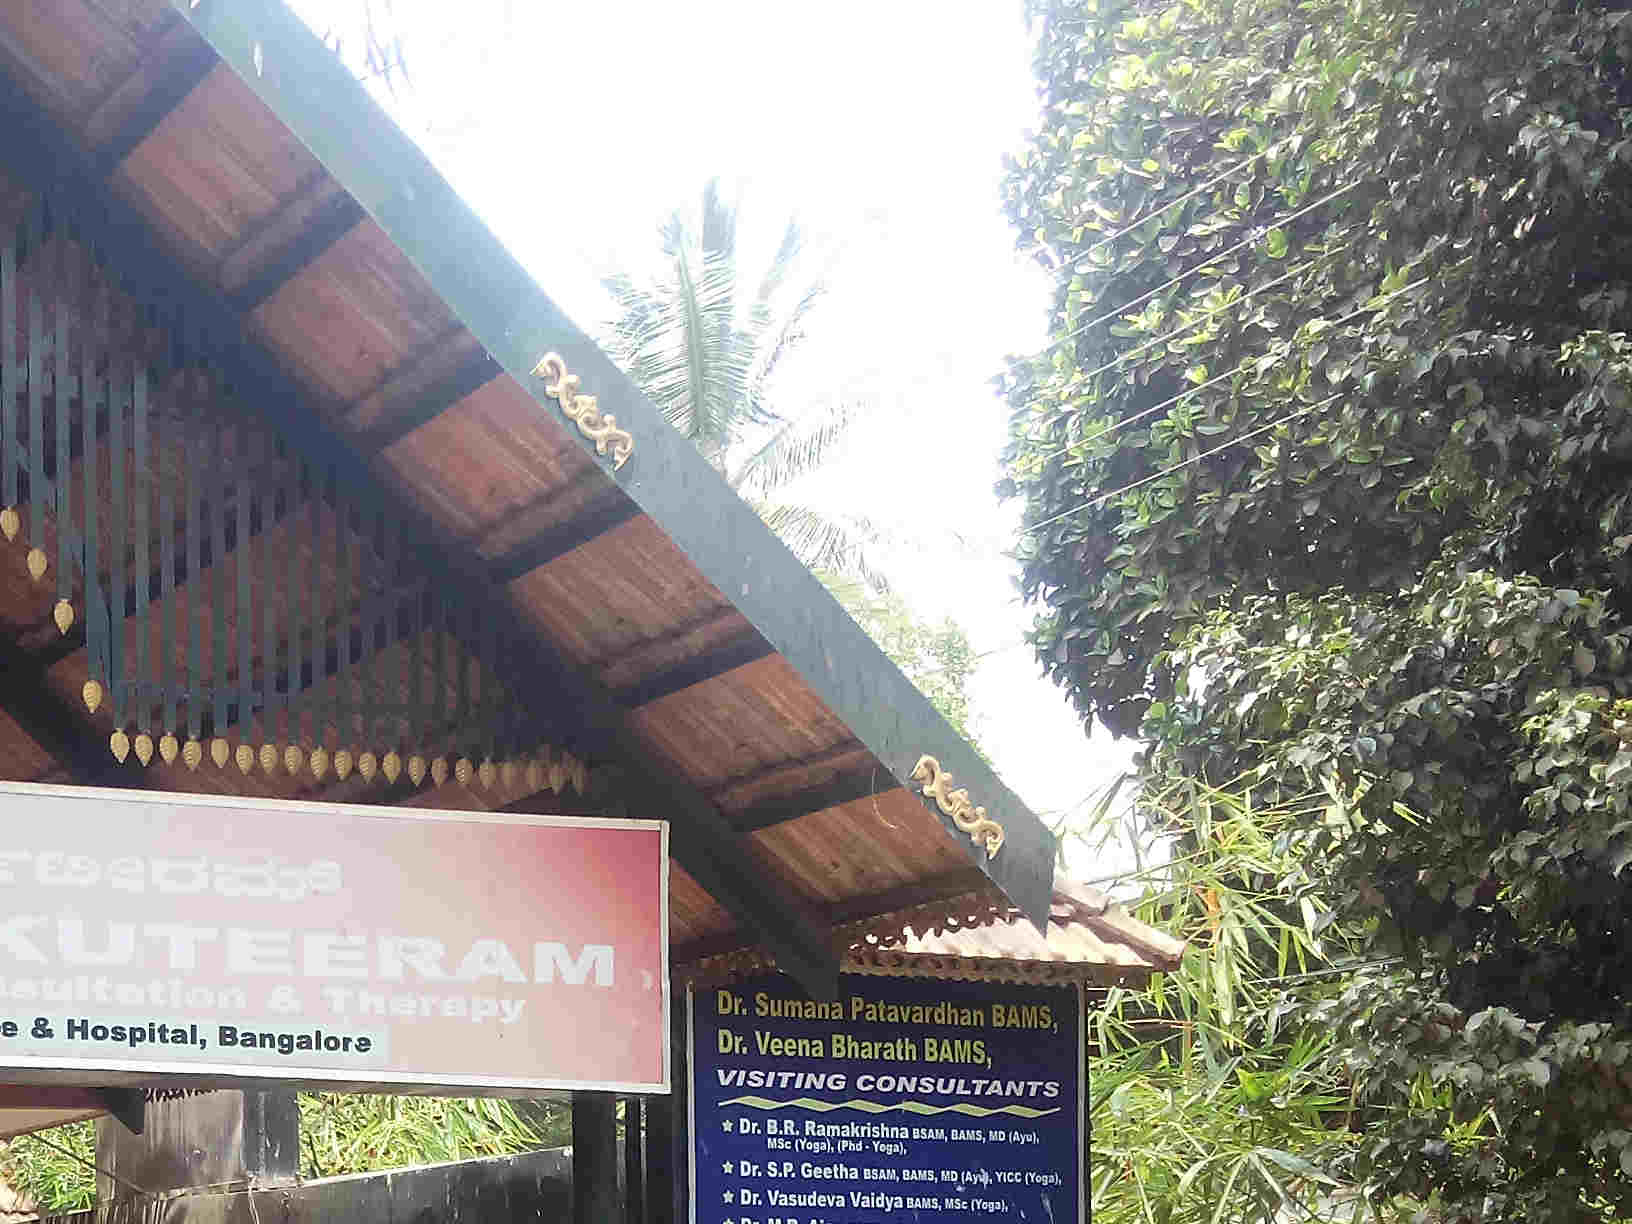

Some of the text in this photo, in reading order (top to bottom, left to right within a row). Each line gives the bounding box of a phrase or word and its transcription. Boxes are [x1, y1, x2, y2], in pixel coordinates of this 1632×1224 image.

[269, 983, 305, 1017] &
[322, 986, 530, 1025] Therapy
[718, 990, 1058, 1034] Dr. Sumana Patavardhan BAMS,
[30, 1018, 55, 1041] &
[66, 1018, 208, 1049] Hospital,
[218, 1025, 373, 1055] Bangalore
[718, 1028, 993, 1069] Dr. Veena Bharath BAMS,
[717, 1069, 1060, 1098] VISITING CONSULTANTS
[739, 1118, 1040, 1144] Dr. B.R. Ramakrishna BSAM, BAMS, MD (Ayu),
[767, 1138, 792, 1149] MSc
[794, 1138, 835, 1152] (Yoga),
[837, 1140, 863, 1153] (Phd
[872, 1141, 907, 1155] Yoga),
[740, 1160, 762, 1177] Dr.
[767, 1162, 796, 1178] S.P.
[800, 1162, 859, 1179] Geetha
[863, 1168, 899, 1182] BSAM,
[902, 1169, 938, 1183] BAMS,
[940, 1170, 958, 1181] MD
[995, 1171, 1022, 1183] YICC
[1024, 1172, 1062, 1186] (Yoga),
[740, 1189, 1009, 1213] Dr. Vasudeva Vaidya BAMS, MSc (Yoga),
